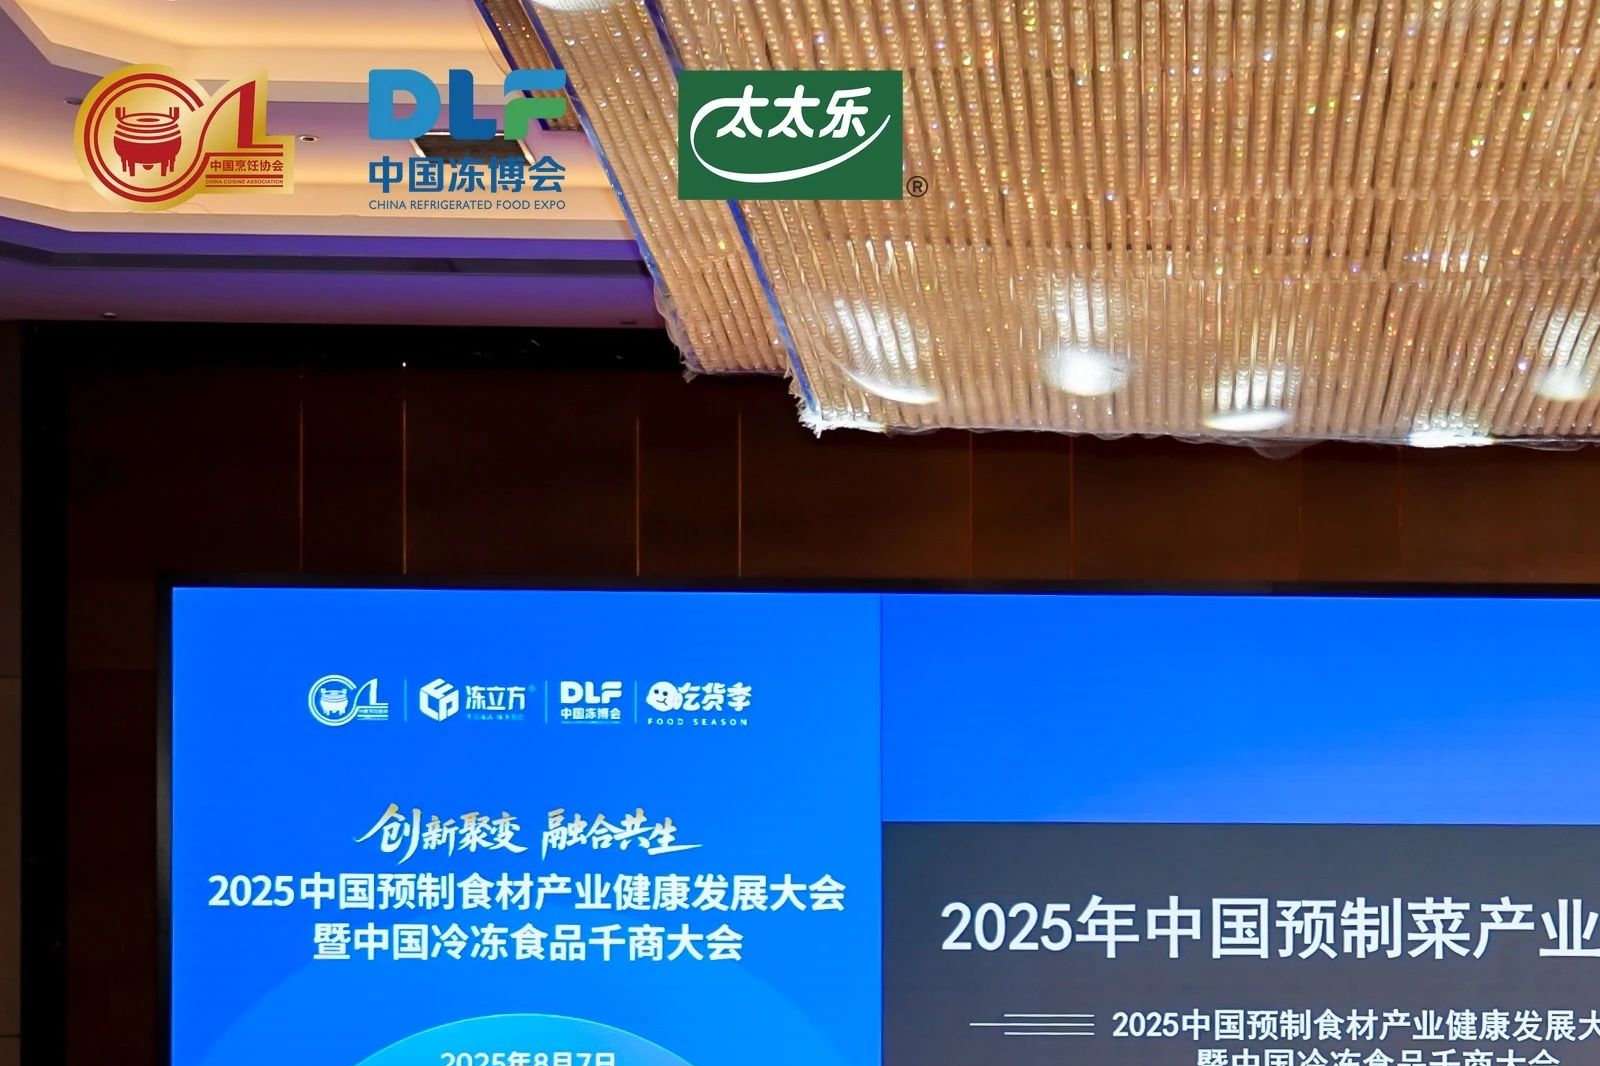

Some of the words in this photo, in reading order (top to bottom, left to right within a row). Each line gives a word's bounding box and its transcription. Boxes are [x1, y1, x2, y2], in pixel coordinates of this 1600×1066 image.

[465, 685, 526, 711] 冻立方
[560, 680, 622, 704] DLF
[560, 707, 622, 720] 中国冻博会
[647, 718, 684, 726] FOOD
[692, 718, 749, 726] SEASON
[355, 803, 528, 864] 创新聚变
[540, 807, 703, 860] 融合共生
[208, 871, 846, 912] 2025中国预制食材产业健康发展大会
[313, 922, 744, 962] 暨中国冷冻食品千商大会
